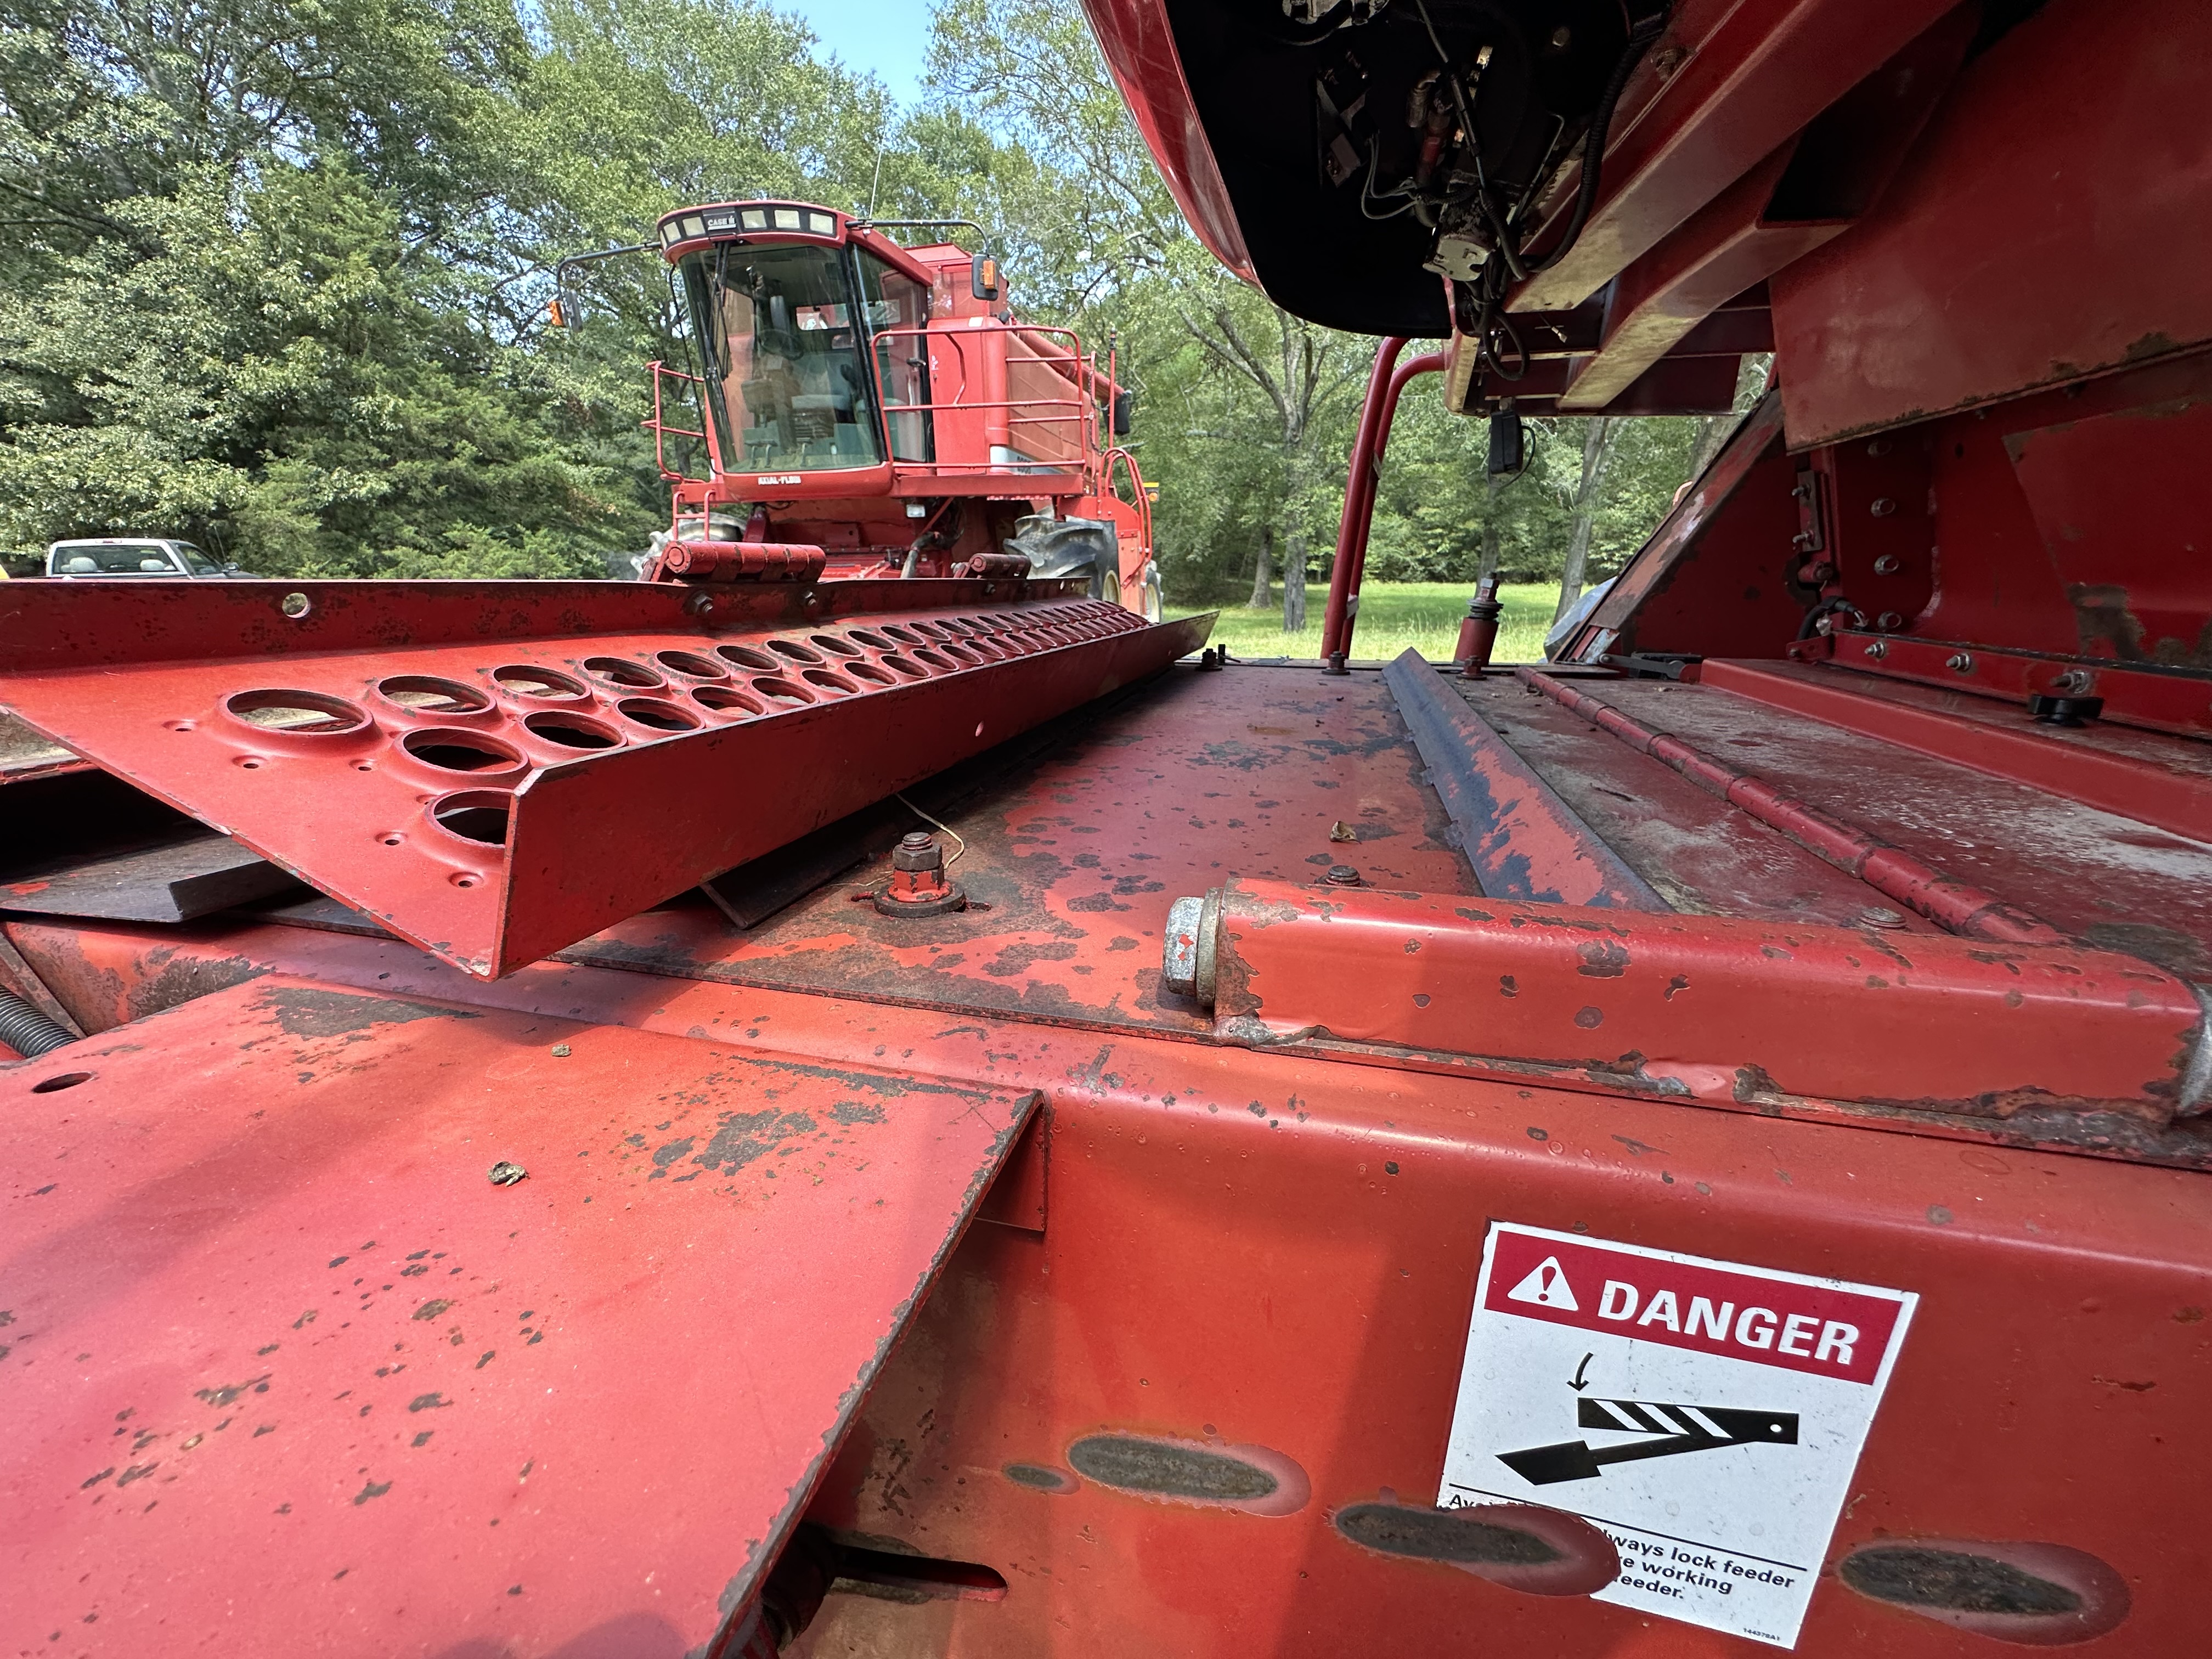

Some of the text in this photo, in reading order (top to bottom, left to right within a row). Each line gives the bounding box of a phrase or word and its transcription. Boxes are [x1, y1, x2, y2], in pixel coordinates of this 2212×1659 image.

[708, 218, 727, 227] CASE
[1598, 1279, 1859, 1365] DANGER
[1604, 1529, 1795, 1588] ways lock feeder
[1614, 1576, 1684, 1599] eeder.
[1642, 1561, 1733, 1594] working
